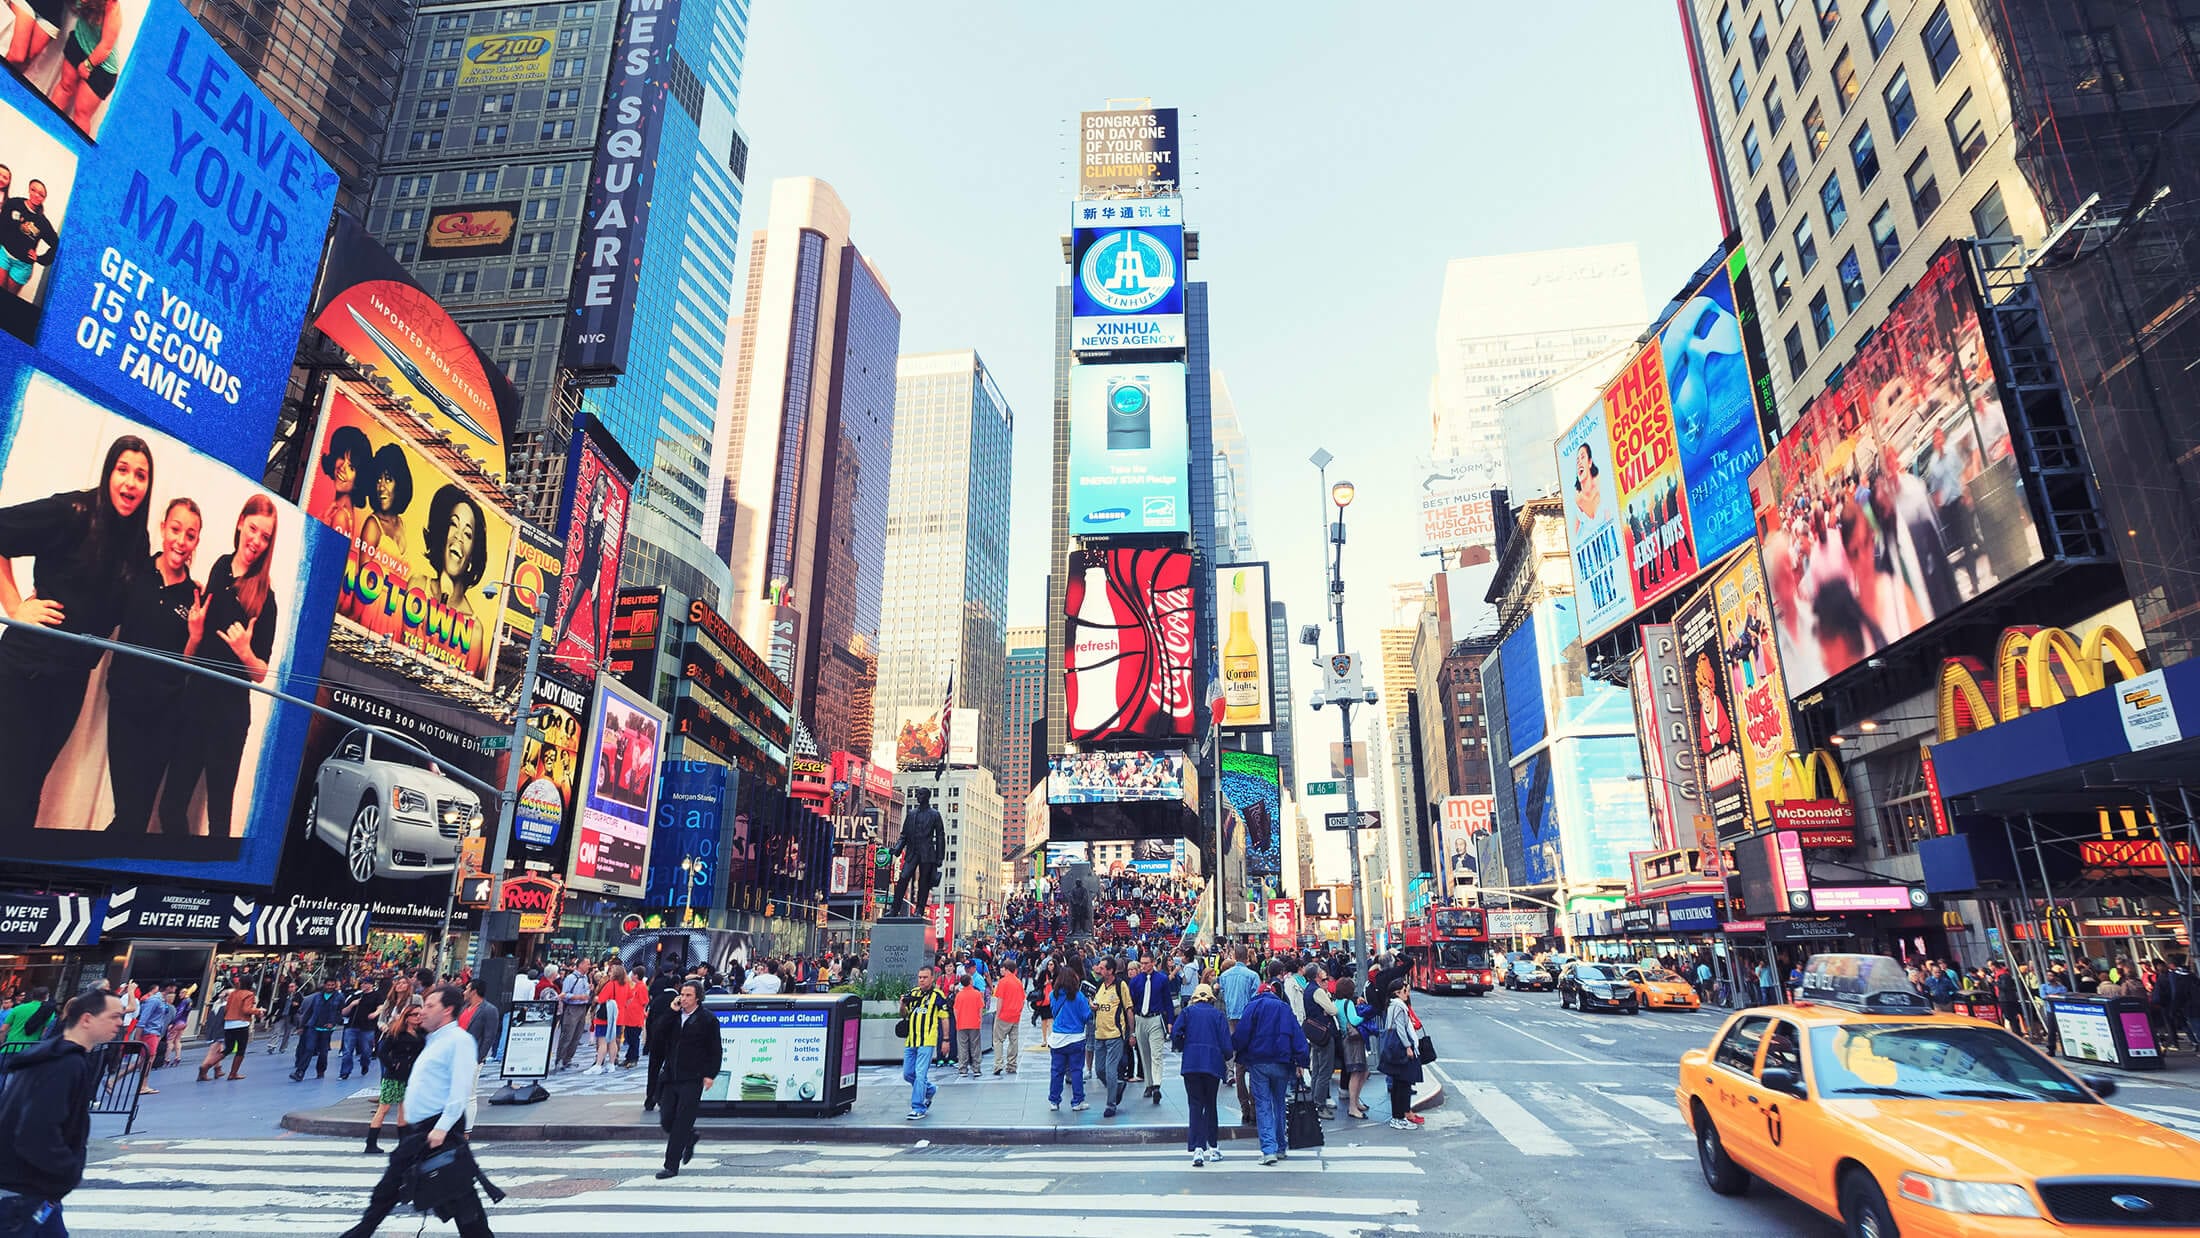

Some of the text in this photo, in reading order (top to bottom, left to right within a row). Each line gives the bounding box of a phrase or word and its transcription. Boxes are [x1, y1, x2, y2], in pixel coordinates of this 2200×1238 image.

[474, 37, 545, 64] Z100
[167, 25, 308, 203] LEAVE
[1085, 114, 1157, 128] CONGRATS
[1085, 126, 1167, 140] ON DAY ONE
[1086, 140, 1143, 153] OF YOUR
[1085, 164, 1161, 178] CLINTON P.
[169, 107, 287, 267] YOUR
[585, 96, 642, 306] SQUARE
[1083, 205, 1171, 220] 新华通讯社
[119, 169, 270, 330] MARK
[101, 246, 223, 356] GET YOUR
[1105, 292, 1157, 307] XINHUA
[370, 294, 423, 349] IMPORTED
[425, 346, 451, 377] FROM
[1096, 322, 1161, 336] XINHUA
[91, 281, 242, 404] 15 SECONDS
[578, 333, 606, 344] NYC
[1081, 335, 1175, 346] NEWS AGENCY
[76, 315, 193, 415] OF FAME.
[1606, 346, 1662, 418] THE
[1612, 382, 1663, 441] CROWD
[1615, 405, 1669, 469] GOES
[1618, 431, 1674, 496] WILD!
[1710, 450, 1729, 469] The
[1691, 444, 1760, 507] PHANTOM
[1423, 496, 1453, 509] BEST
[1454, 490, 1490, 504] MUSIC
[1089, 511, 1126, 520] SAMSUNG
[1424, 500, 1493, 522] THE BES
[1707, 494, 1752, 535] OPERA
[1425, 515, 1481, 533] MUSICAL
[1427, 524, 1493, 541] THIS CENTU
[1633, 527, 1662, 571] JERSEY
[1660, 514, 1686, 551] BOYS
[354, 536, 410, 577] BROADWAY
[515, 539, 562, 577] venue
[514, 560, 545, 614] Q
[343, 550, 475, 655] MOTOWN
[620, 595, 659, 605] REUTERS
[402, 632, 467, 672] THE MUSICAL
[1076, 639, 1119, 652] refresh
[1226, 667, 1257, 681] Corona
[533, 676, 586, 715] A JOY RIDE!
[1744, 683, 1774, 722] NICE
[333, 690, 392, 721] CHRYSLER
[395, 713, 415, 729] 300
[419, 722, 460, 745] MOTOWN
[1657, 636, 1699, 800] PALACE
[1747, 709, 1783, 749] WORK
[1106, 751, 1138, 760] HYUNDAI
[793, 759, 827, 774] eese's
[672, 792, 717, 804] Morgan Stanley
[1308, 783, 1315, 795] W
[1317, 783, 1327, 794] 46
[1330, 818, 1347, 826] ONE
[1776, 808, 1853, 819] McDonald's
[832, 814, 876, 840] HEY'S
[1450, 819, 1461, 830] at
[579, 842, 598, 865] CNN
[1141, 862, 1169, 870] HYUNDAI
[162, 895, 211, 906] AMERICAN EAGLE
[290, 894, 469, 920] Chrysler.com MotownTheMusic.com
[5, 905, 49, 919] WE'RE
[139, 911, 221, 929] ENTER HERE
[311, 915, 335, 925] WE'RE
[1246, 901, 1262, 923] R
[1274, 902, 1291, 936] tkts
[0, 919, 39, 933] OPEN
[309, 926, 329, 936] OPEN
[731, 1014, 749, 1023] NYC
[751, 1014, 777, 1023] Green
[778, 1014, 795, 1023] and
[796, 1013, 825, 1023] Clean!
[751, 1037, 777, 1046] recycle
[794, 1036, 821, 1046] recycle
[794, 1045, 820, 1053] bottles
[751, 1055, 772, 1063] paper
